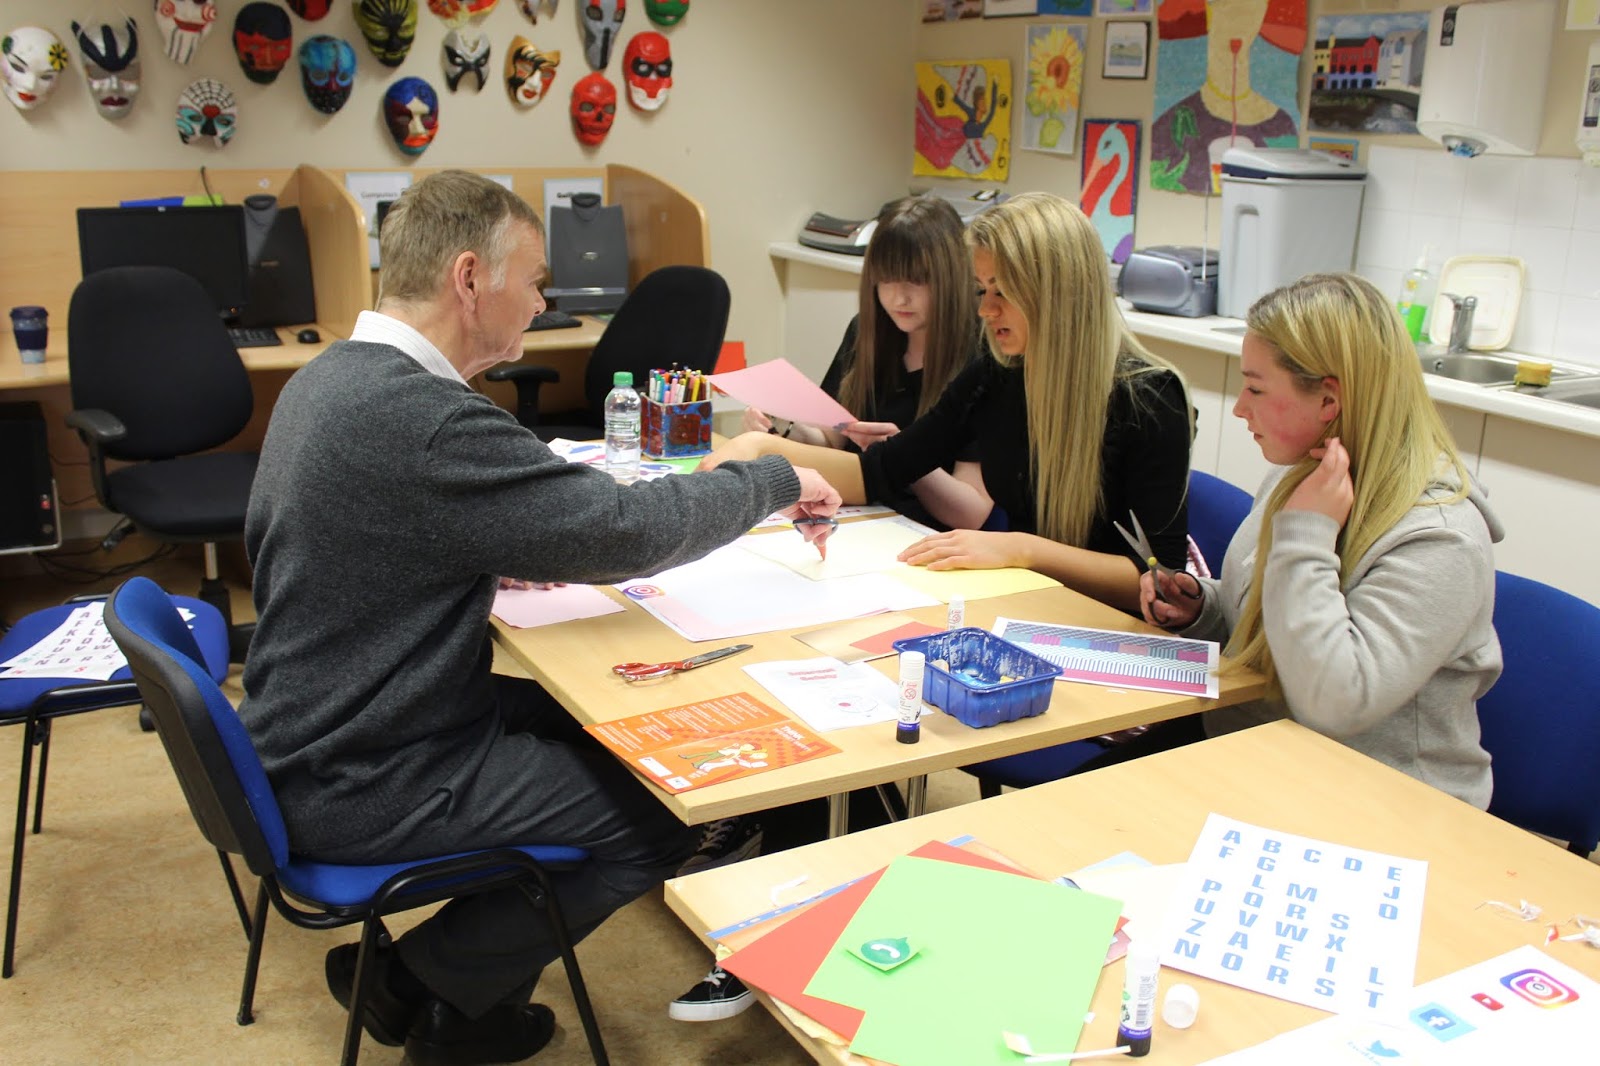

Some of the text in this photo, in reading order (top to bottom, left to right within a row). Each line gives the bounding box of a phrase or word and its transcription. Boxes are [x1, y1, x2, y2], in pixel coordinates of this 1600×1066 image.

[1218, 845, 1400, 900] F G J
[1223, 829, 1402, 881] A B C D E
[1201, 879, 1350, 931] P Q R S
[1251, 873, 1398, 920] L M O
[1186, 919, 1384, 985] Z A E I L
[1194, 898, 1346, 952] U V W X
[1173, 939, 1384, 1009] N O R S T
